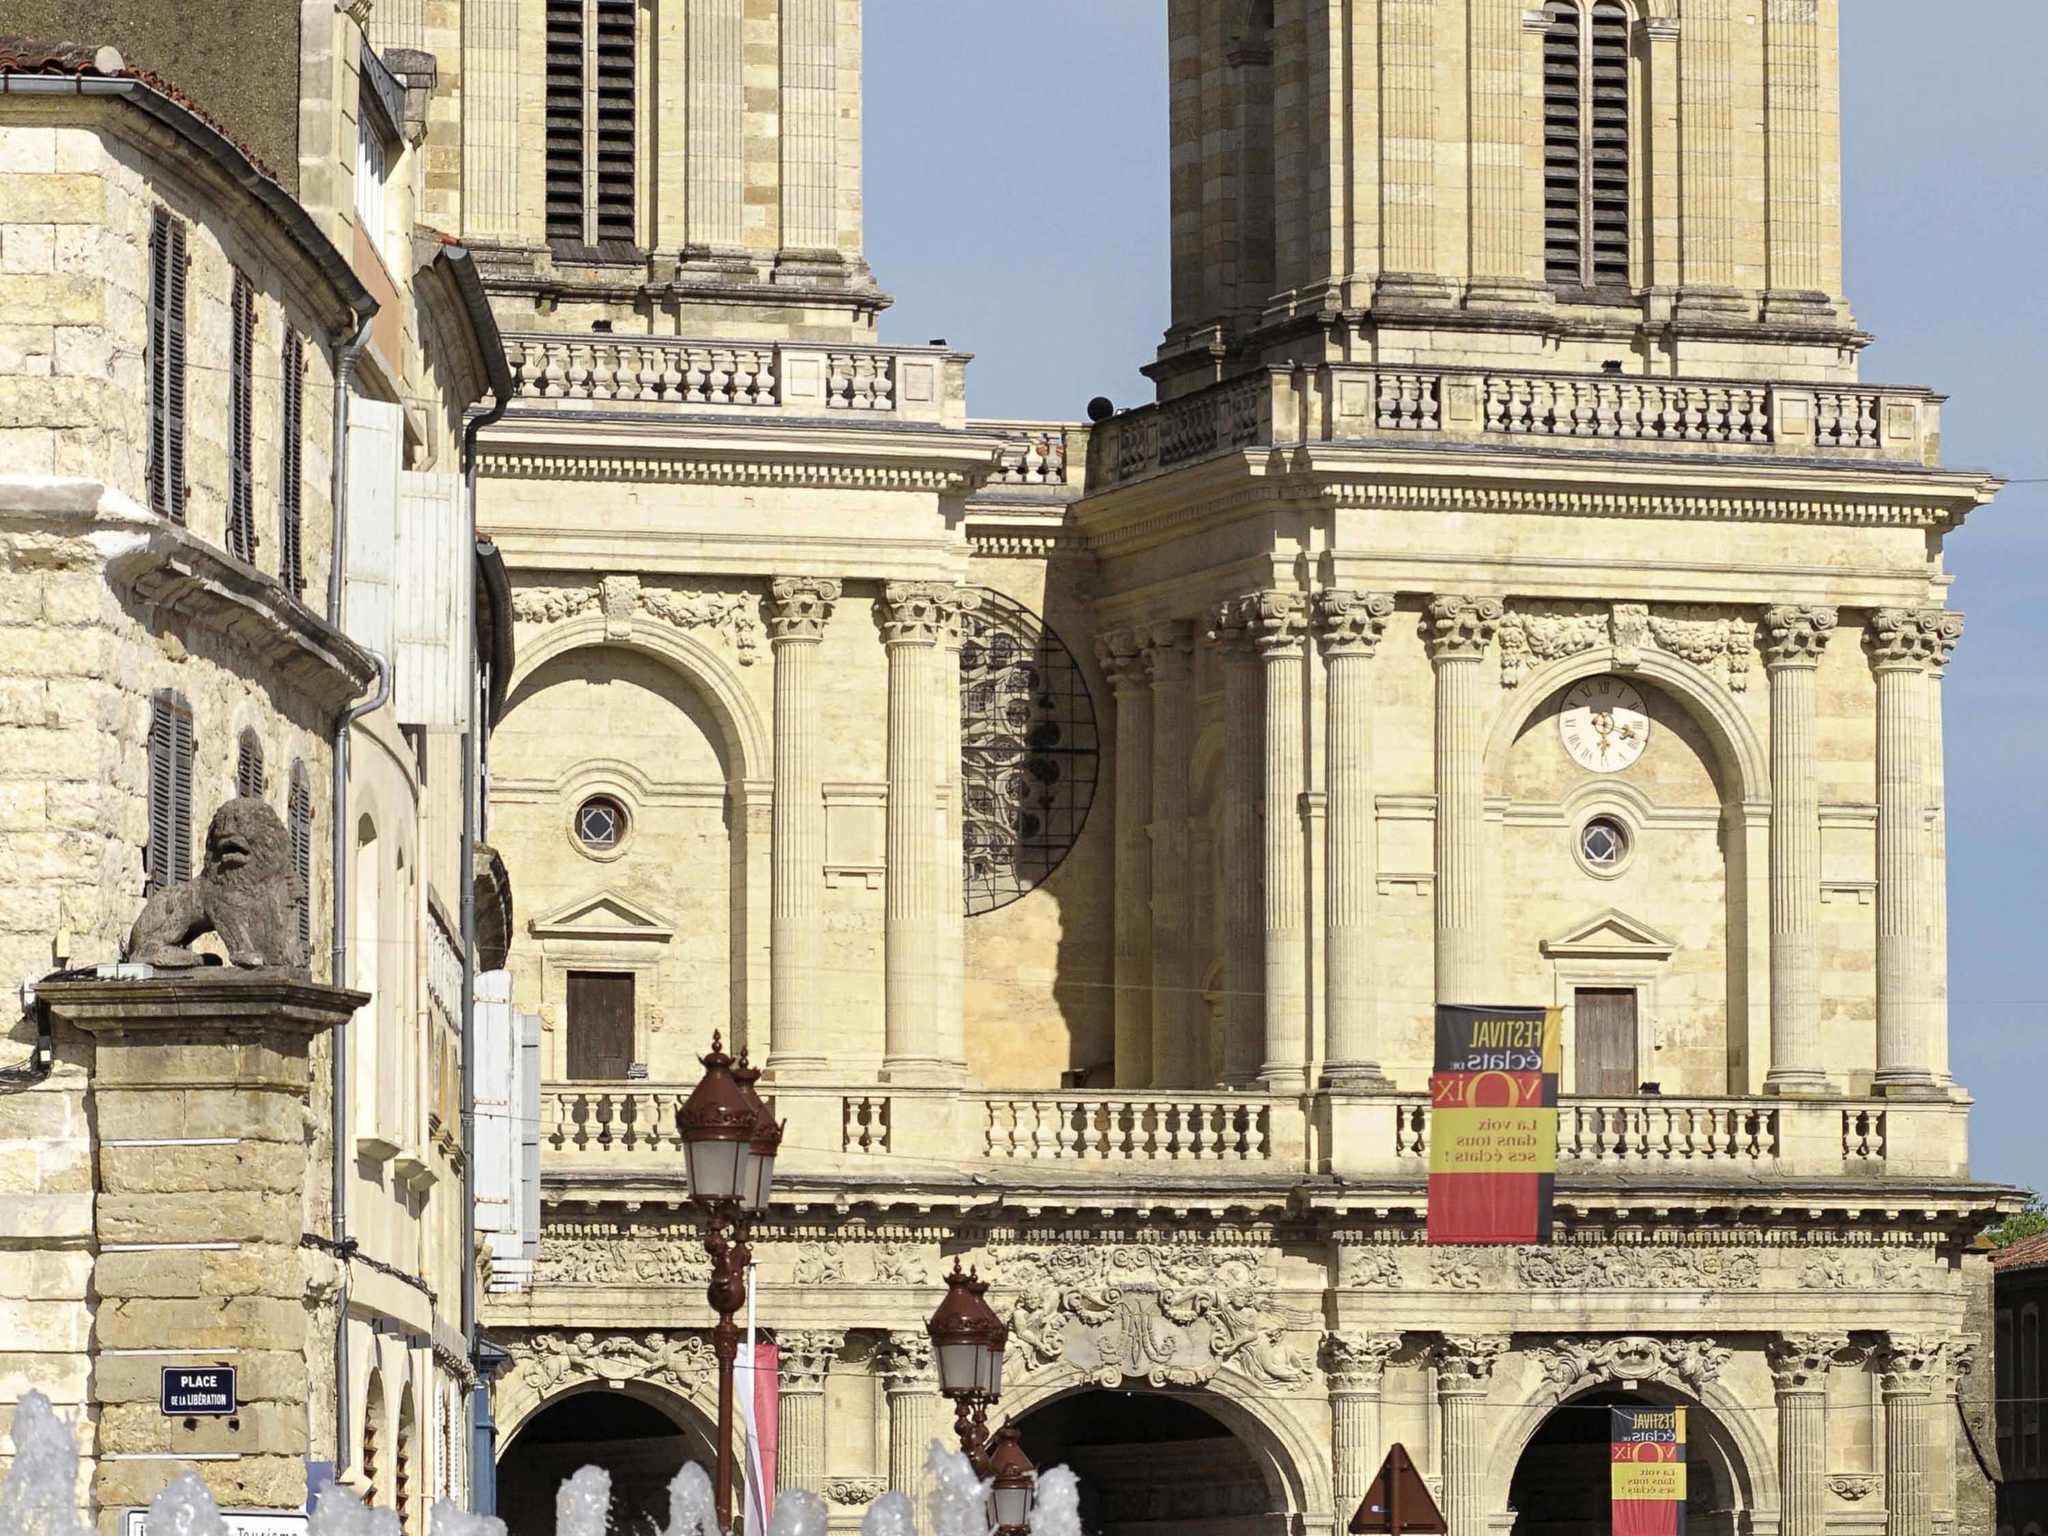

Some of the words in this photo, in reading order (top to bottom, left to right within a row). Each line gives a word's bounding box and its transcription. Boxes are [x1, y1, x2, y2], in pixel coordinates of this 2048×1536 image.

[181, 1376, 218, 1387] PLACE
[171, 1396, 178, 1406] DE
[179, 1396, 186, 1406] LA
[187, 1392, 227, 1406] LIBÉRATION
